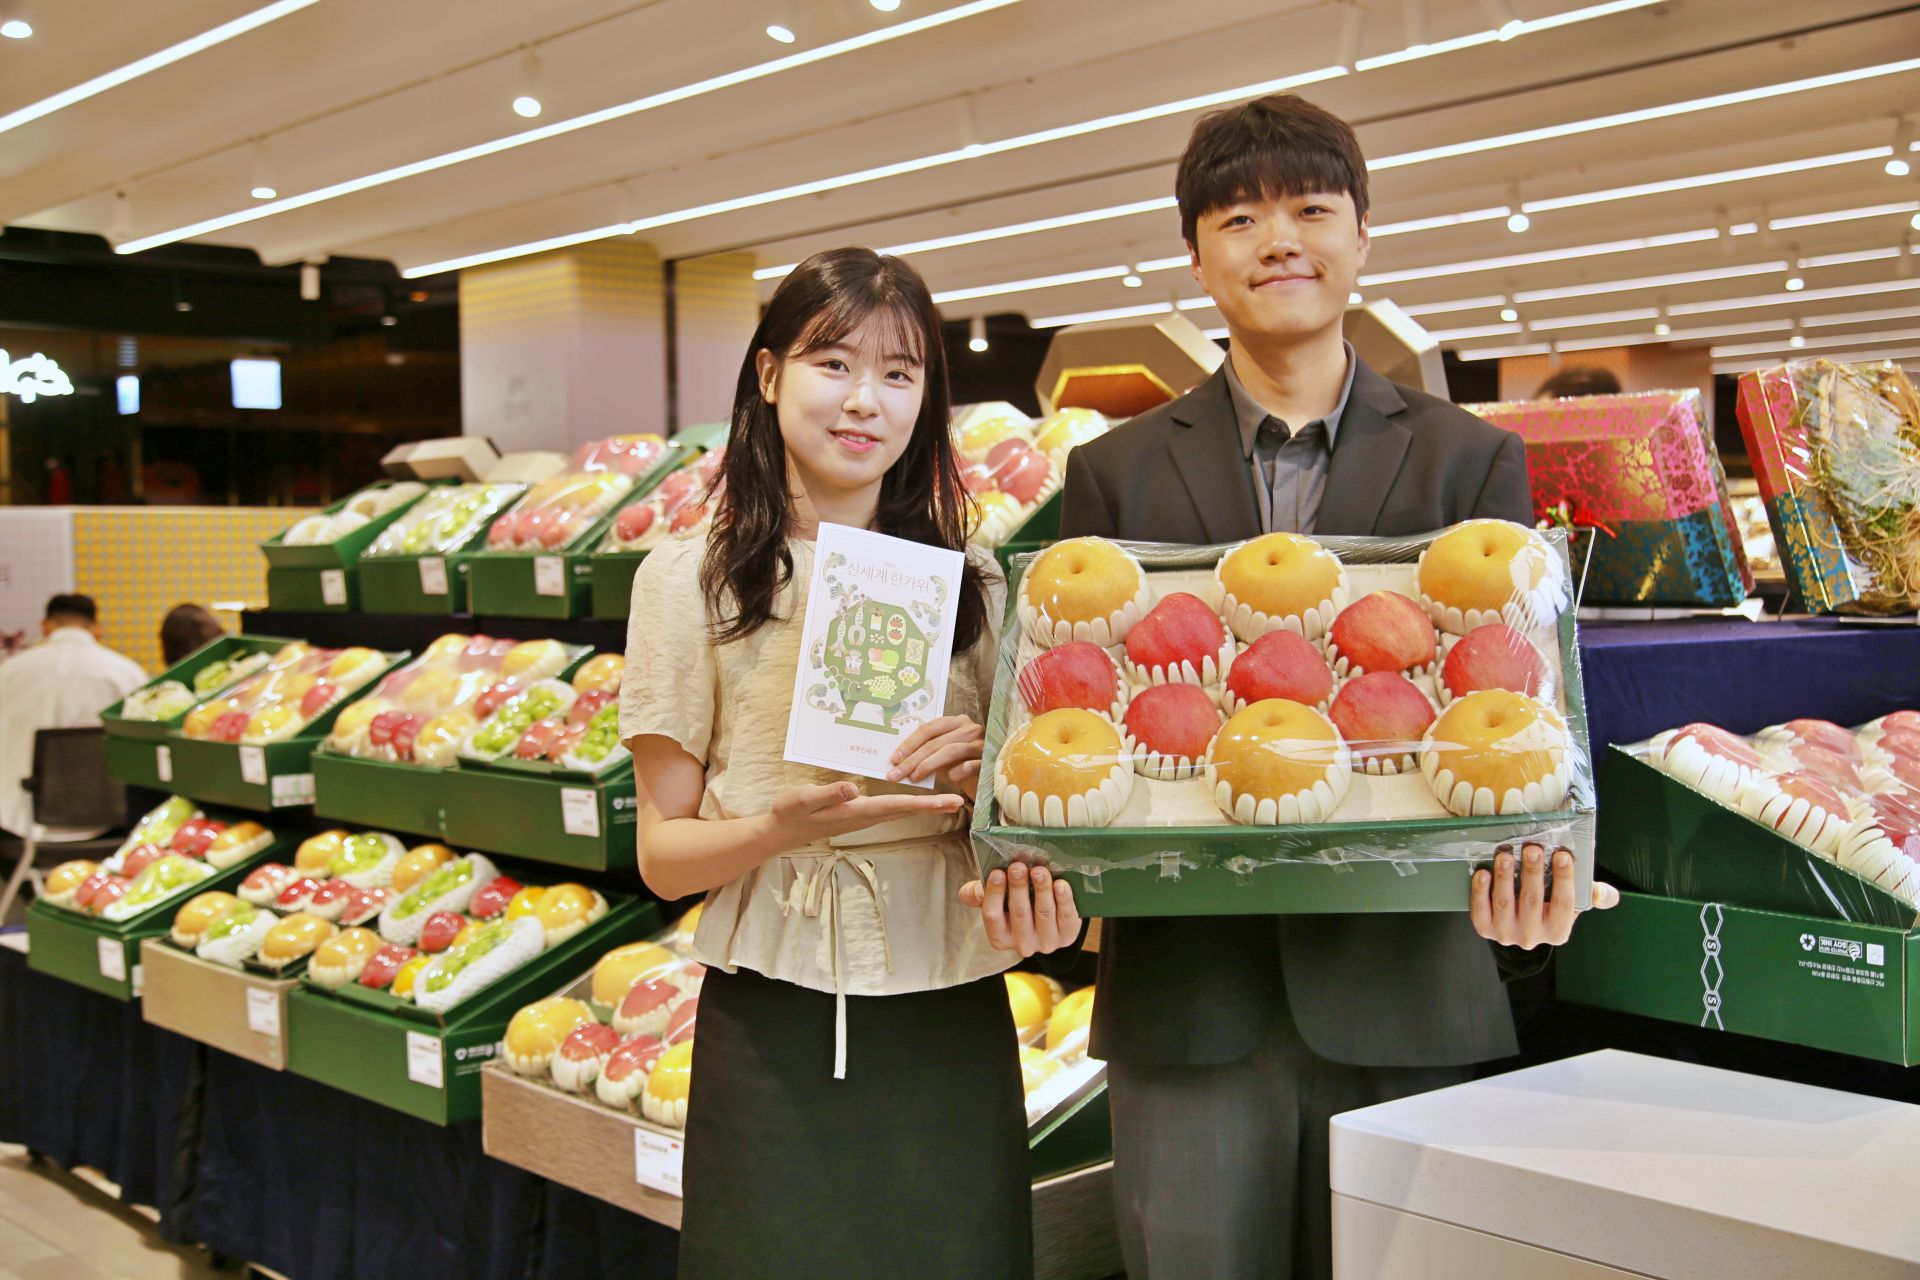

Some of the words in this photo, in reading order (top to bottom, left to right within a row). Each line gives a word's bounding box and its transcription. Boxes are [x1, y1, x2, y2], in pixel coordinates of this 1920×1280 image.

[847, 562, 888, 583] 신세계
[890, 570, 930, 592] 한가위
[1820, 937, 1833, 947] INK
[1833, 940, 1848, 949] SOY
